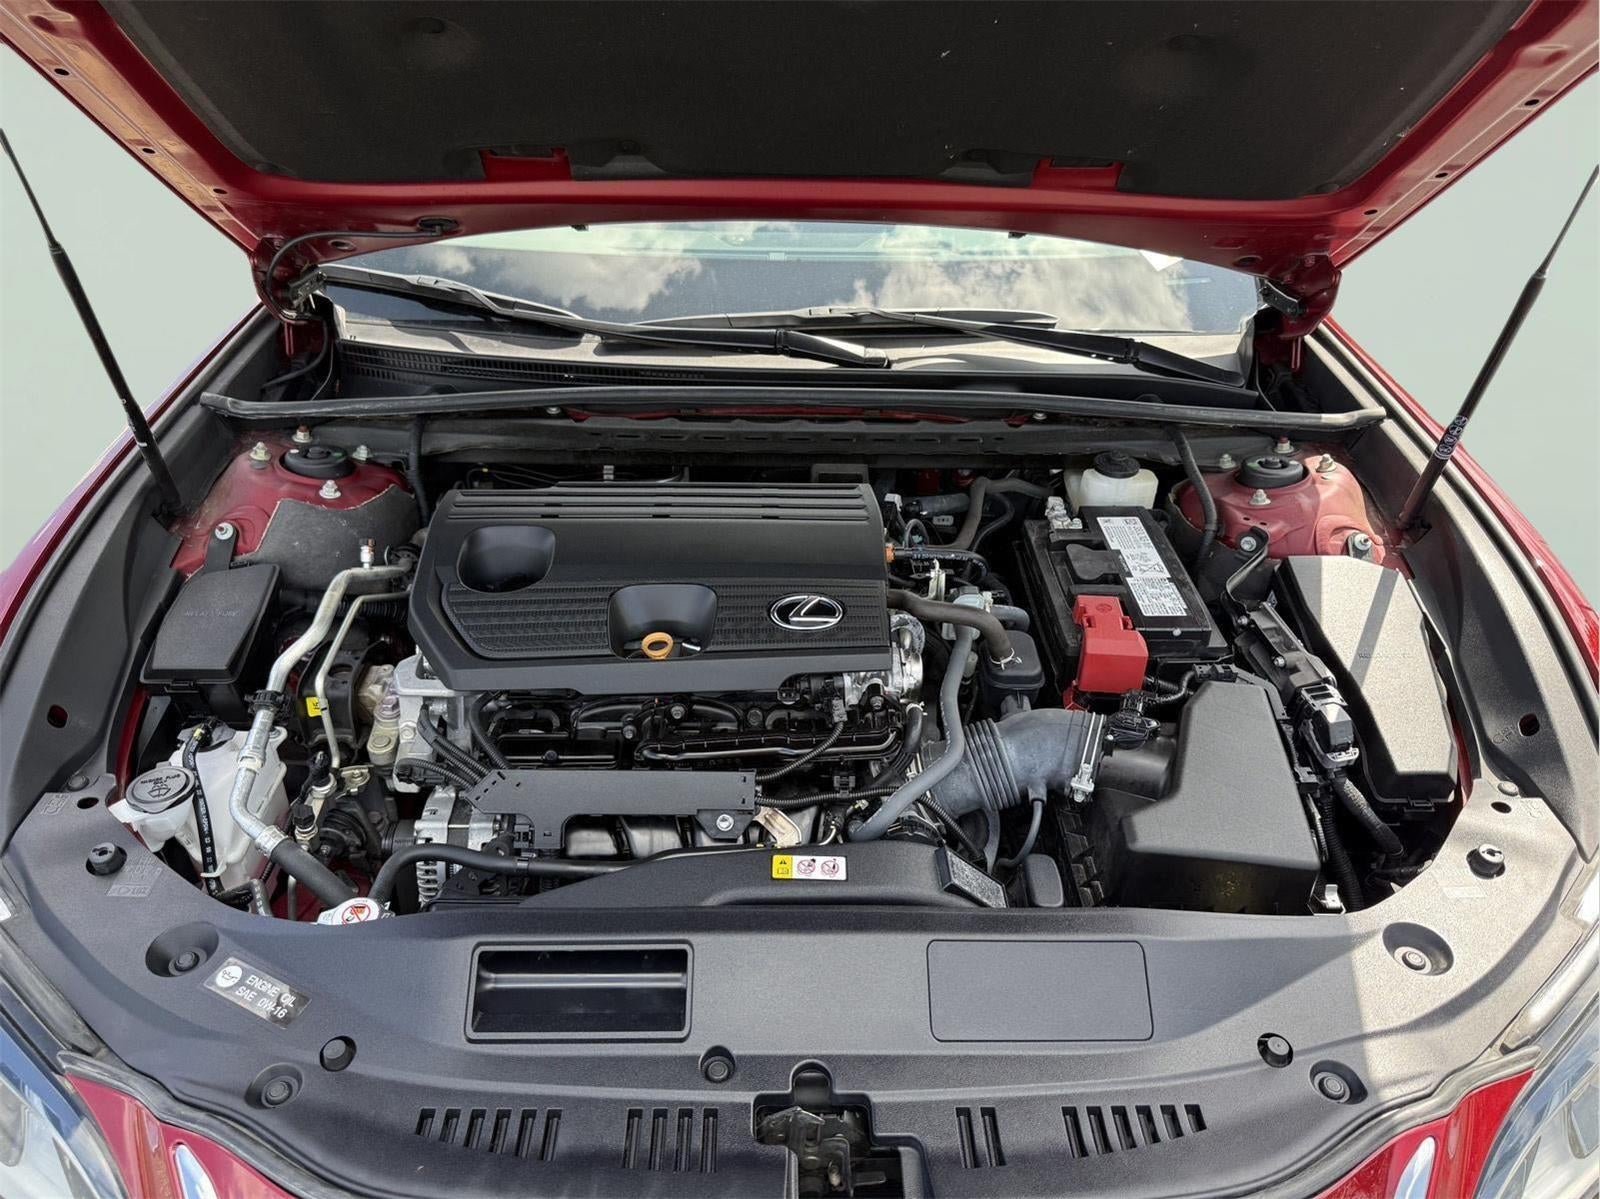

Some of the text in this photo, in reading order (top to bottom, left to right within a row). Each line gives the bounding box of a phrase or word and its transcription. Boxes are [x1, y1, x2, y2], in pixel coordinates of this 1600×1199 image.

[235, 985, 258, 1001] SAE
[246, 975, 297, 1008] ENGINE OIL
